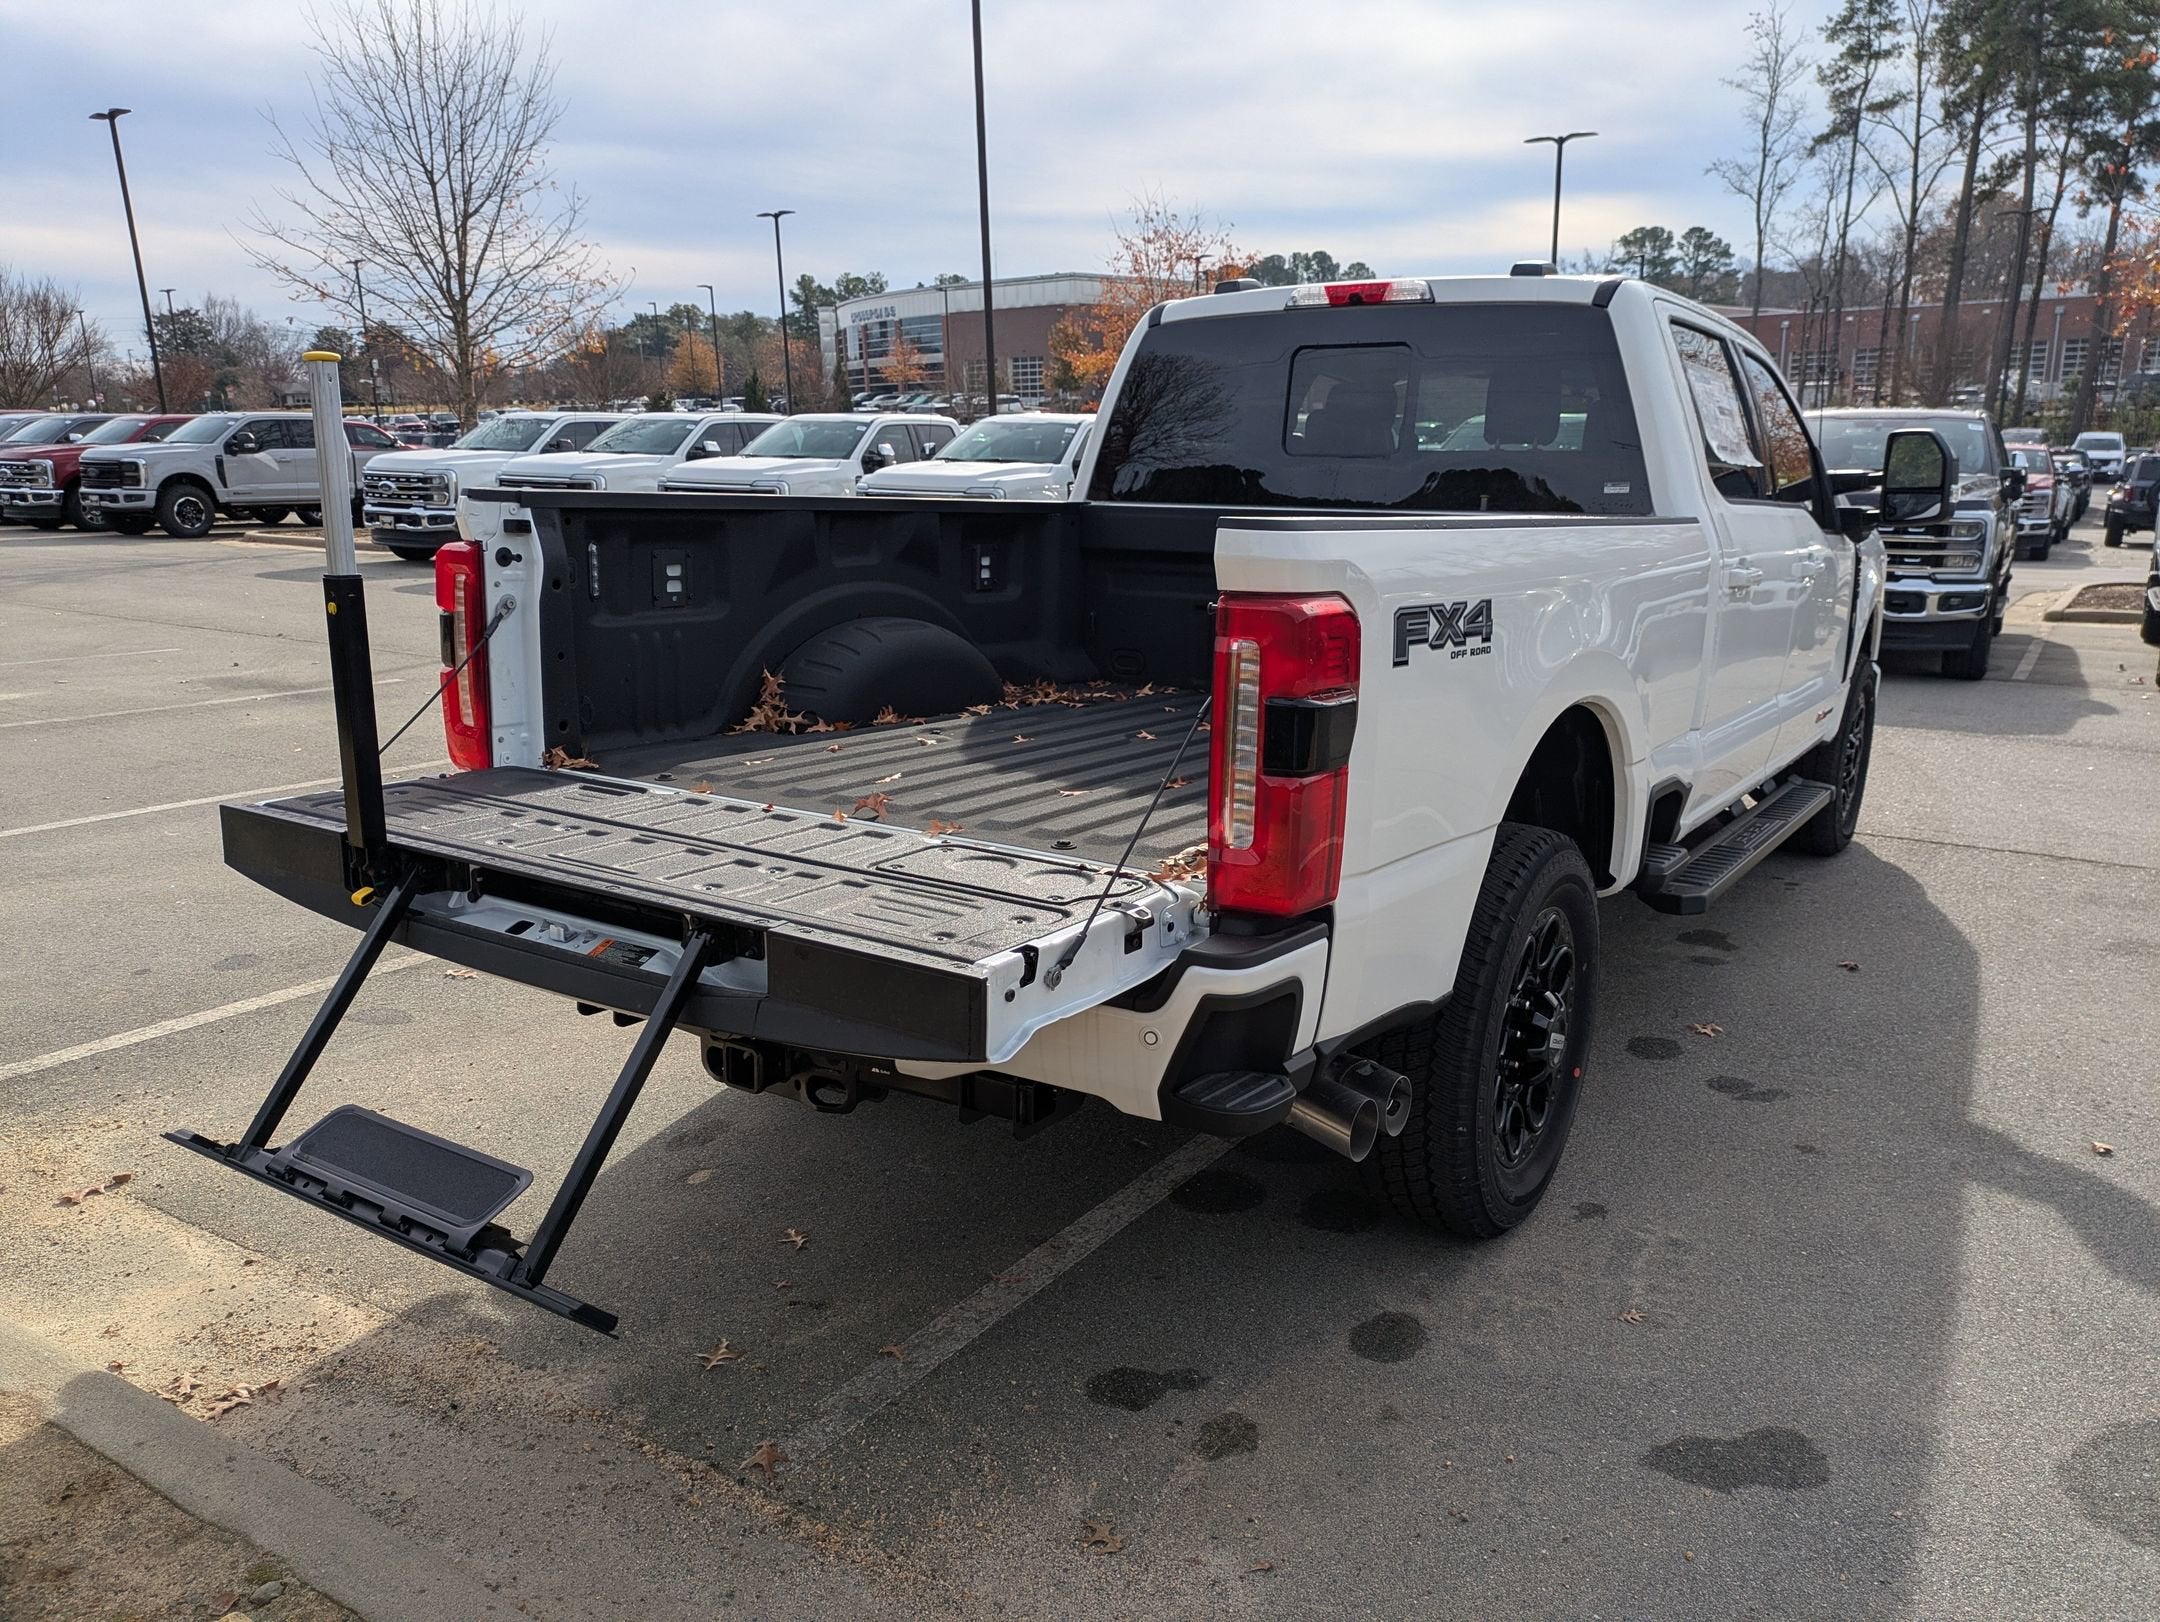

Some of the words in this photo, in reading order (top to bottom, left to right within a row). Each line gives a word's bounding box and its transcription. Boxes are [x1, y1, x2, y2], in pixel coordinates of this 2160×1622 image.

[1393, 598, 1493, 668] FX4
[1450, 649, 1468, 660] OFF
[1470, 645, 1492, 657] ROAD
